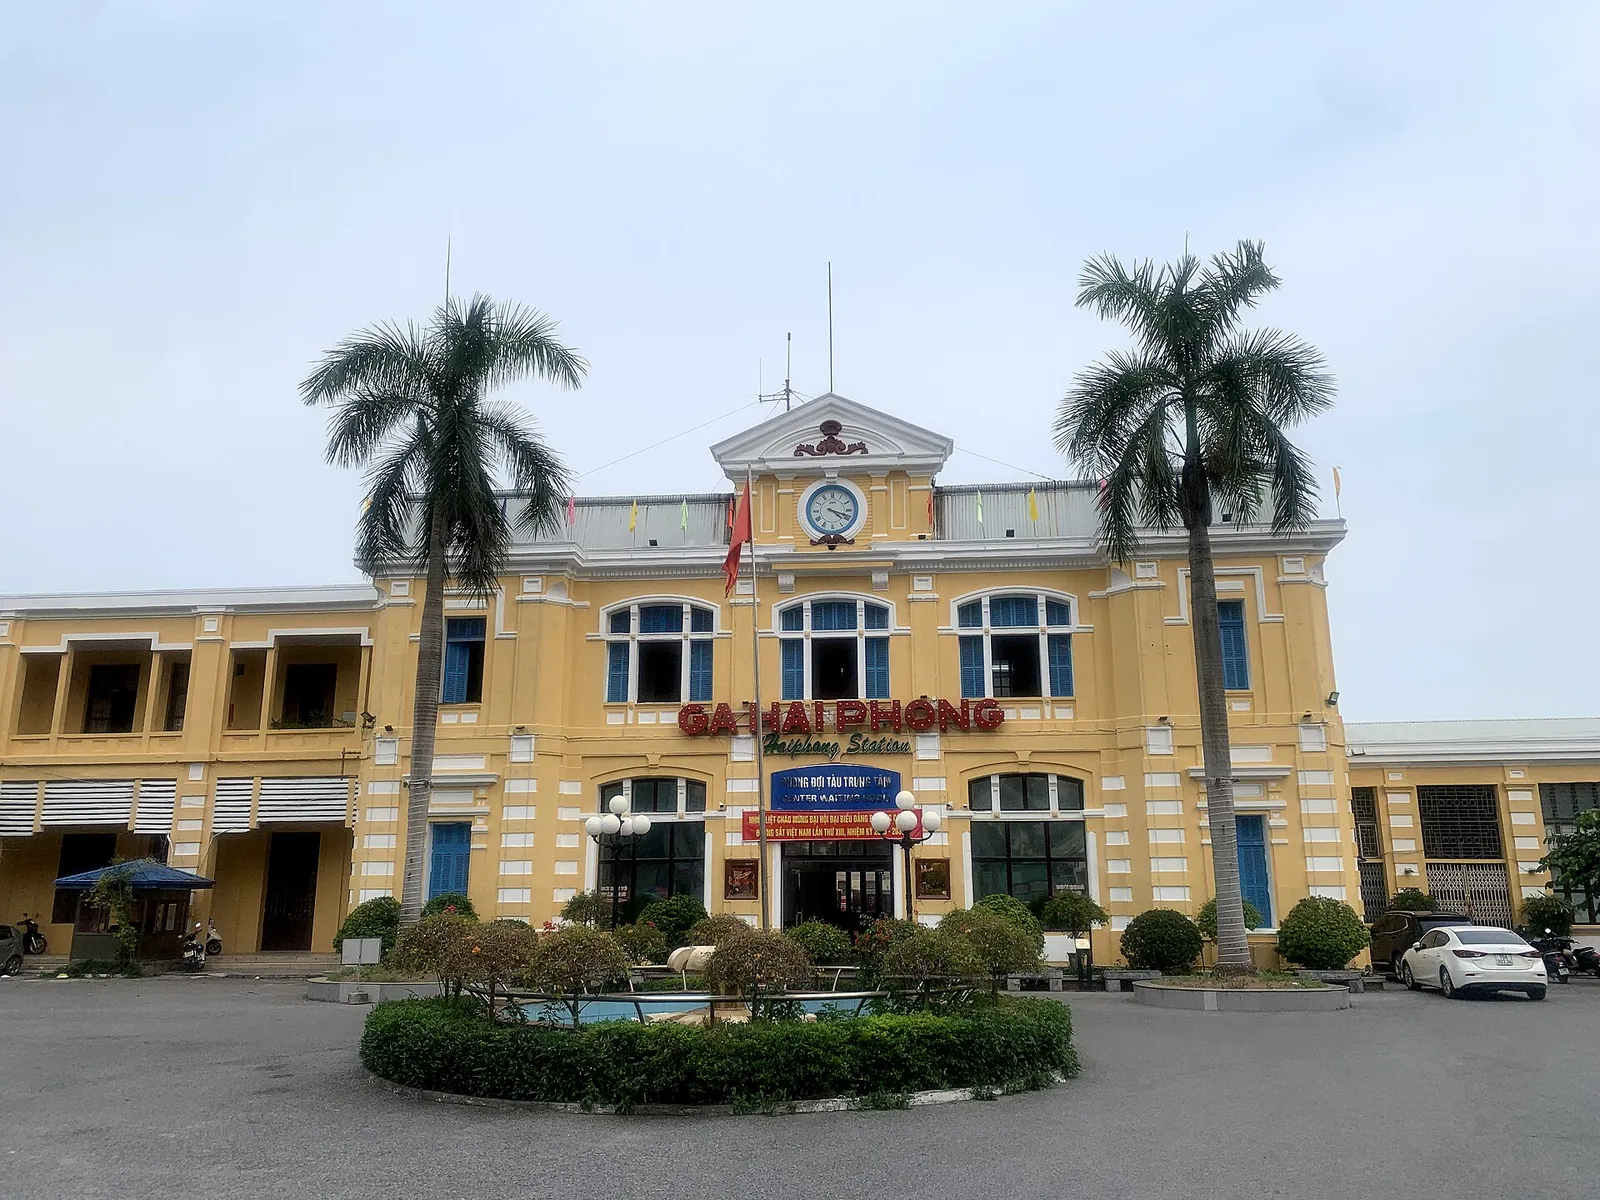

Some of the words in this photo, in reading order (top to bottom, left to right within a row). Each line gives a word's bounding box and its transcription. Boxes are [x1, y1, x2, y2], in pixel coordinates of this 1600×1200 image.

[679, 702, 739, 735] GA
[749, 701, 824, 734] HAI
[837, 699, 1005, 733] PHONG
[762, 733, 841, 760] Haiphong
[846, 732, 911, 753] Station
[827, 774, 842, 788] TÀU
